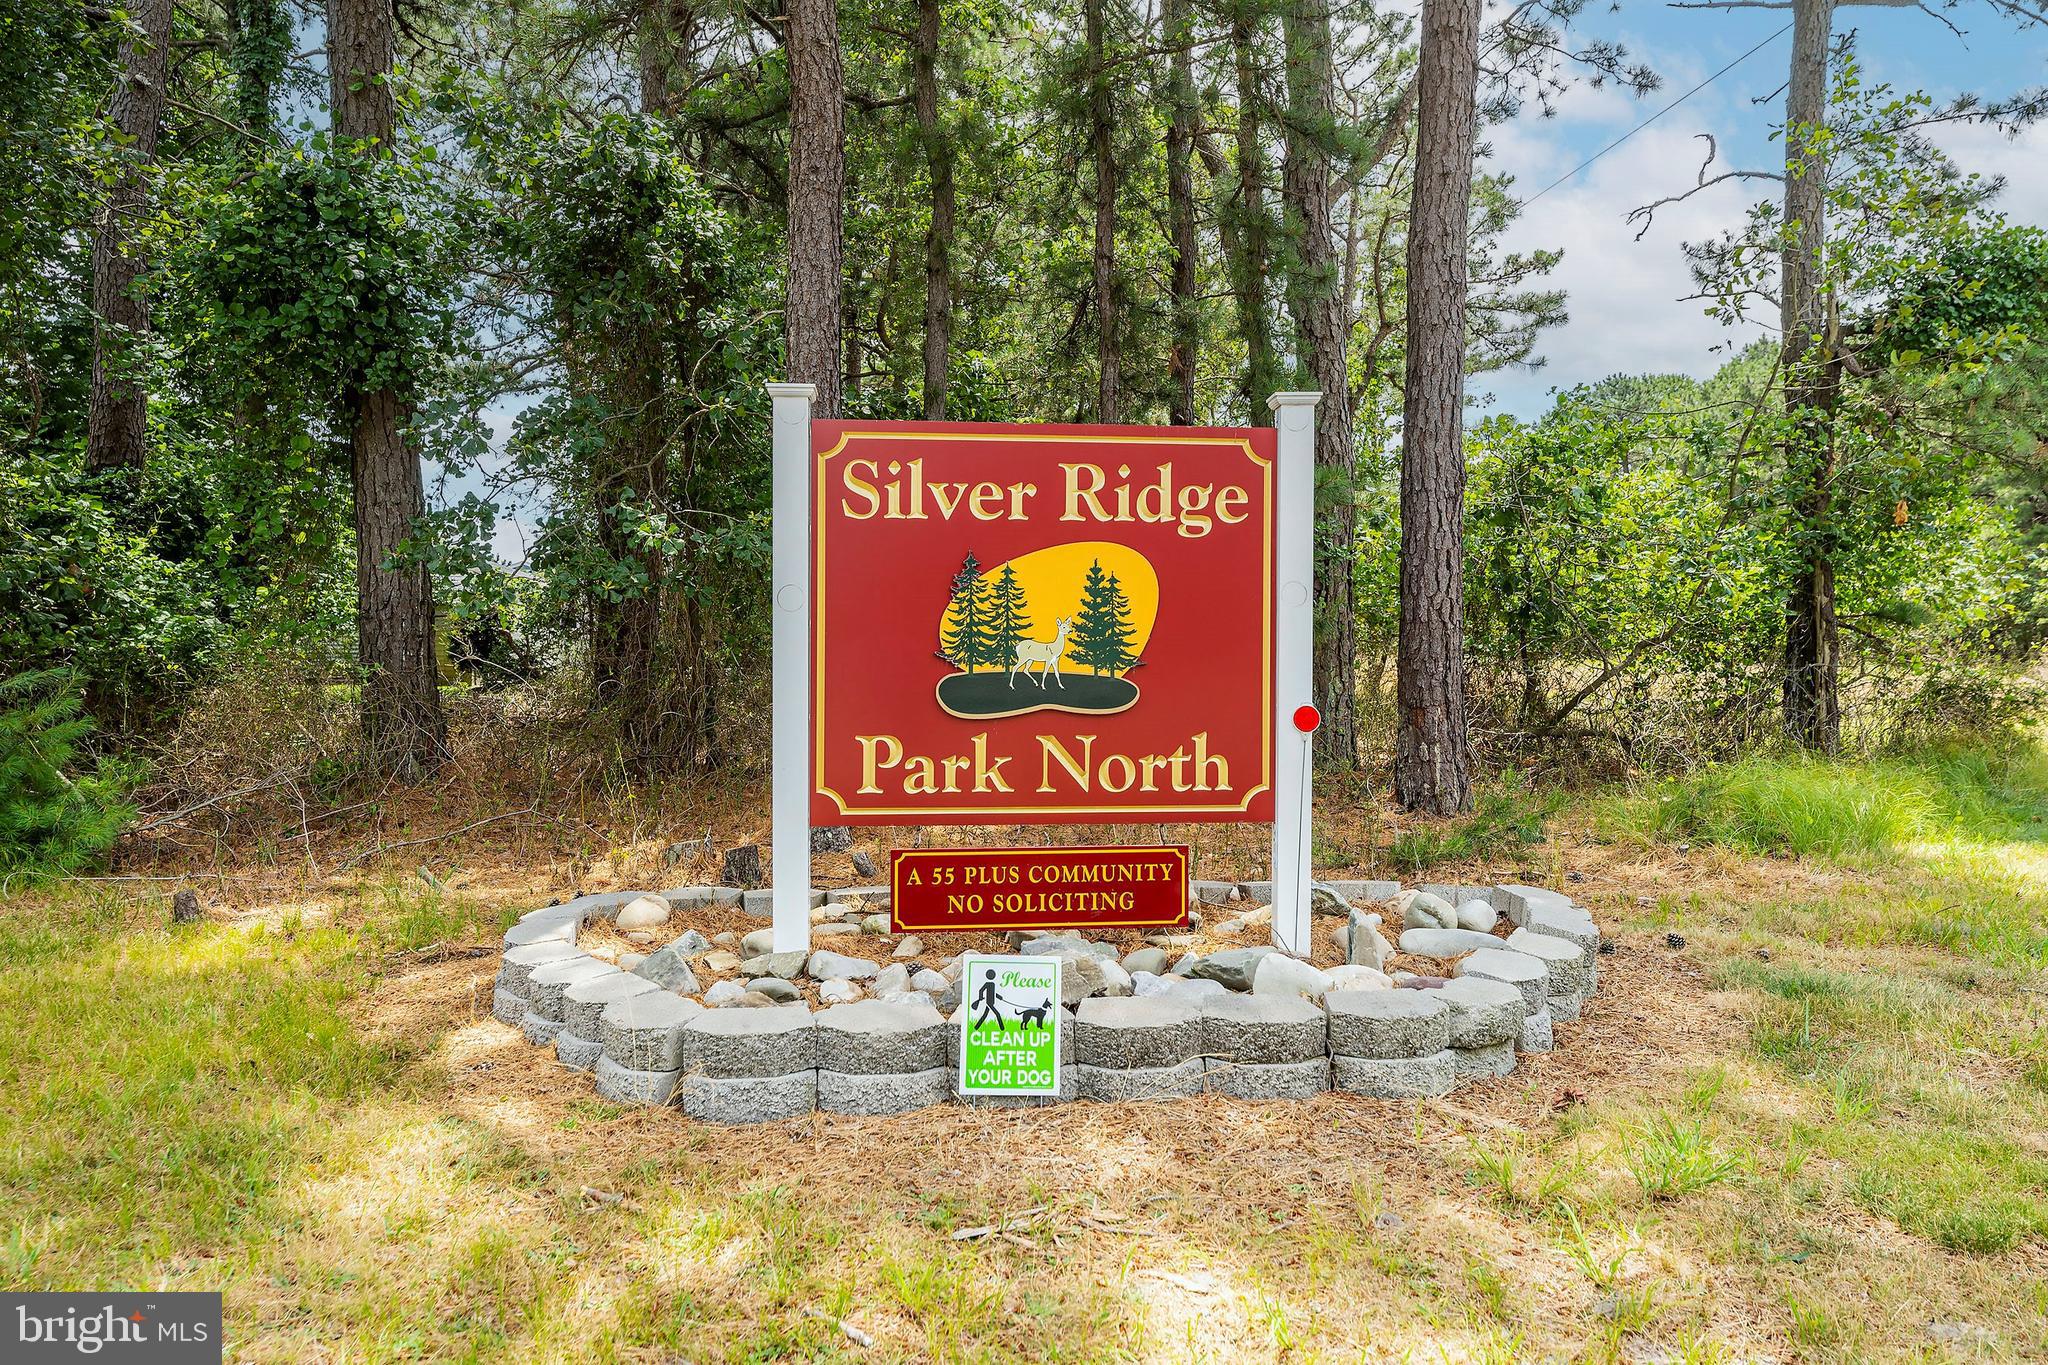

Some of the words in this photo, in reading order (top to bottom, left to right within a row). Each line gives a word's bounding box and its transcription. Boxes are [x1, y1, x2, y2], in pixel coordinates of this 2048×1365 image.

[841, 457, 1037, 521] Silver
[1058, 461, 1250, 538] Ridge
[855, 732, 1015, 795] Park
[1036, 731, 1233, 793] North
[907, 868, 922, 885] A
[932, 867, 955, 885] 55
[965, 866, 1019, 885] PLUS
[1029, 863, 1174, 883] COMMUNITY
[948, 894, 983, 914] NO
[993, 891, 1135, 913] SOLICITING
[1000, 970, 1052, 988] Please
[970, 1031, 1024, 1047] CLEAN
[1030, 1032, 1051, 1047] UP
[983, 1051, 1037, 1066] AFTER
[968, 1069, 1012, 1085] YOUR
[1017, 1070, 1051, 1085] DOG
